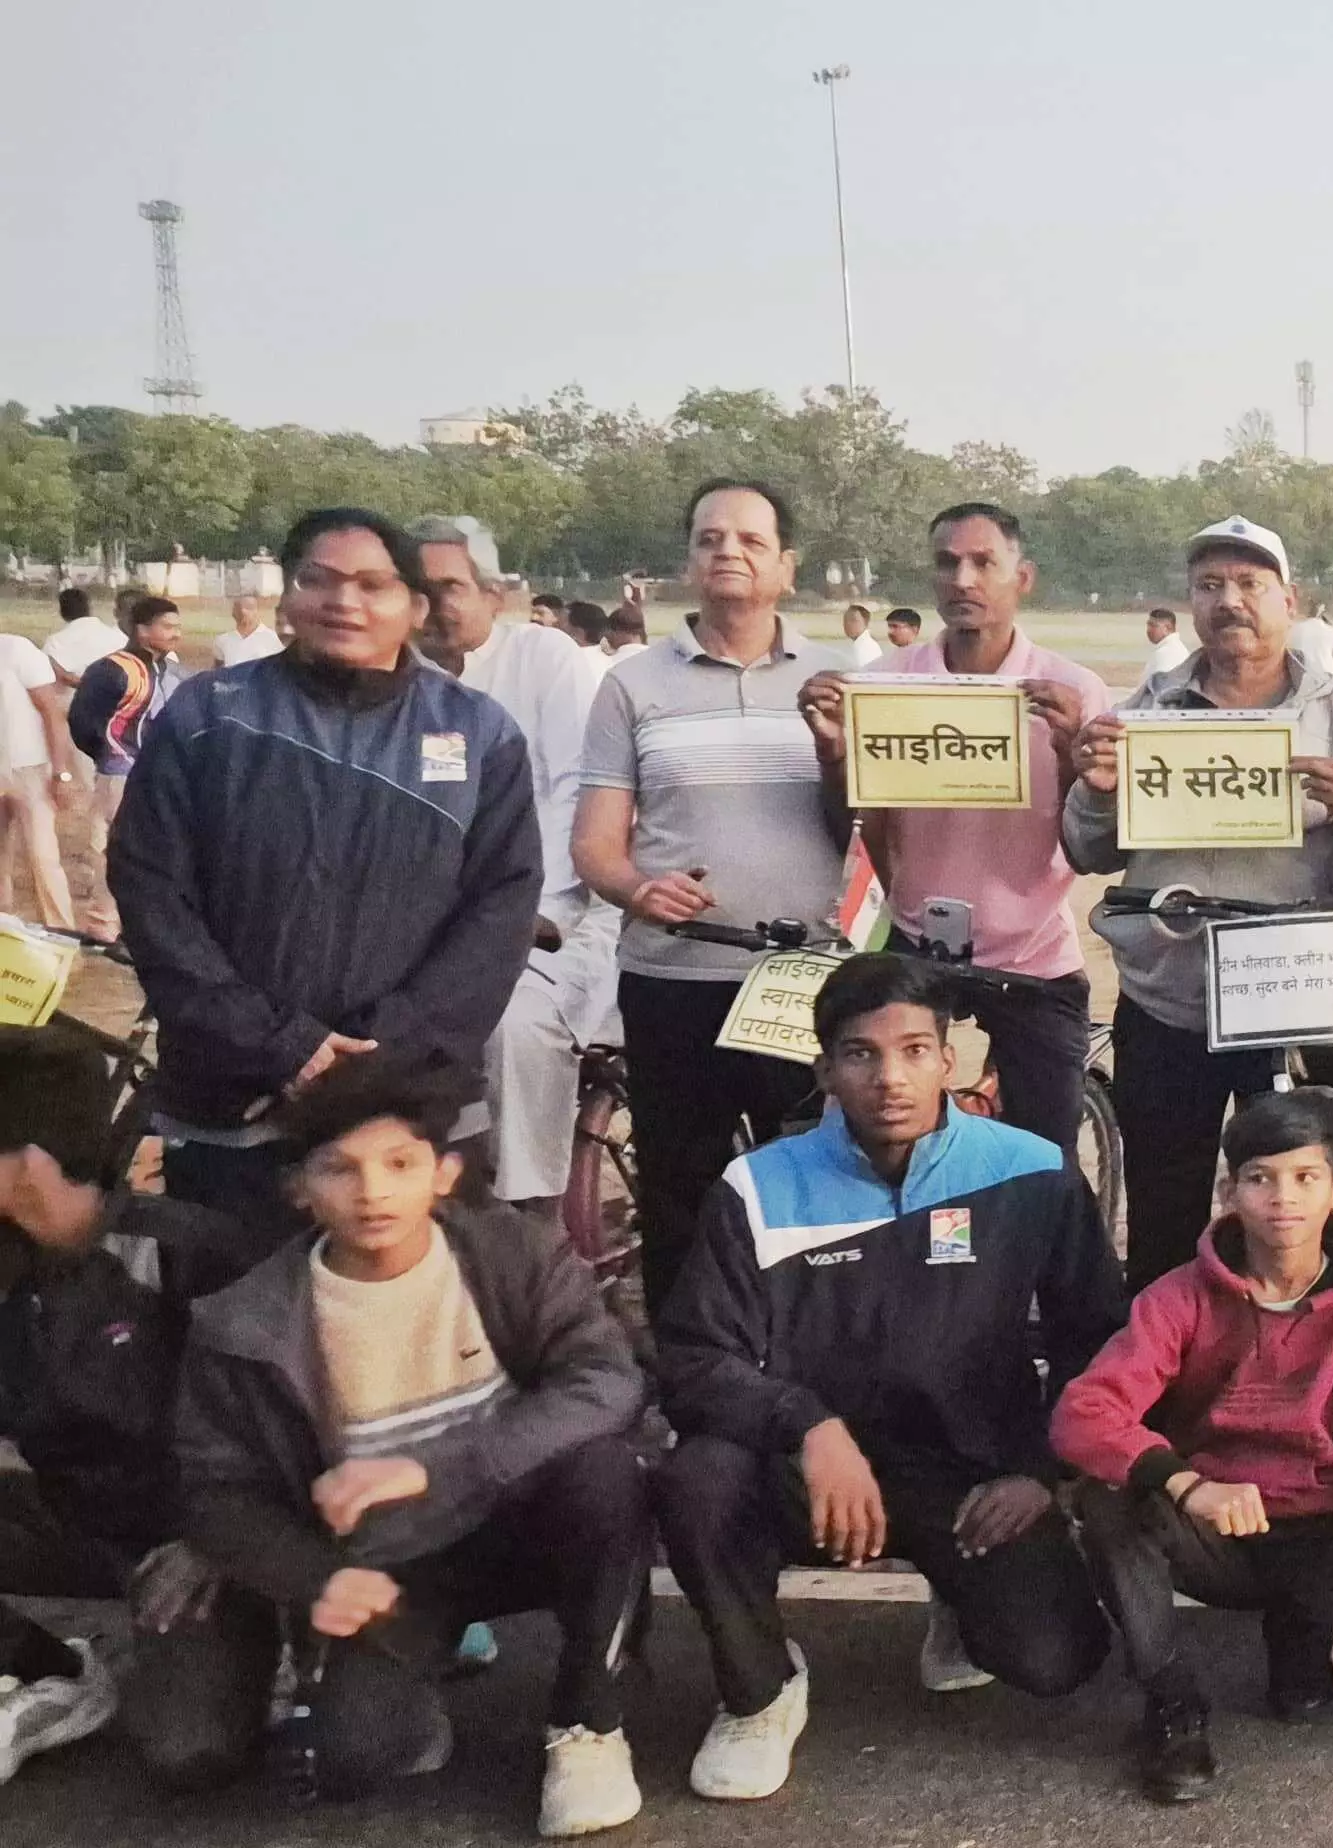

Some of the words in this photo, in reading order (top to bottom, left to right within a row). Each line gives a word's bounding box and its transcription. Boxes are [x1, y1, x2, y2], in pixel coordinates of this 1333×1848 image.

[861, 723, 1011, 765] साइकिल
[1135, 755, 1172, 798] से
[1183, 754, 1282, 800] संदेश
[766, 953, 838, 980] साईक
[804, 1248, 864, 1266] VATS
